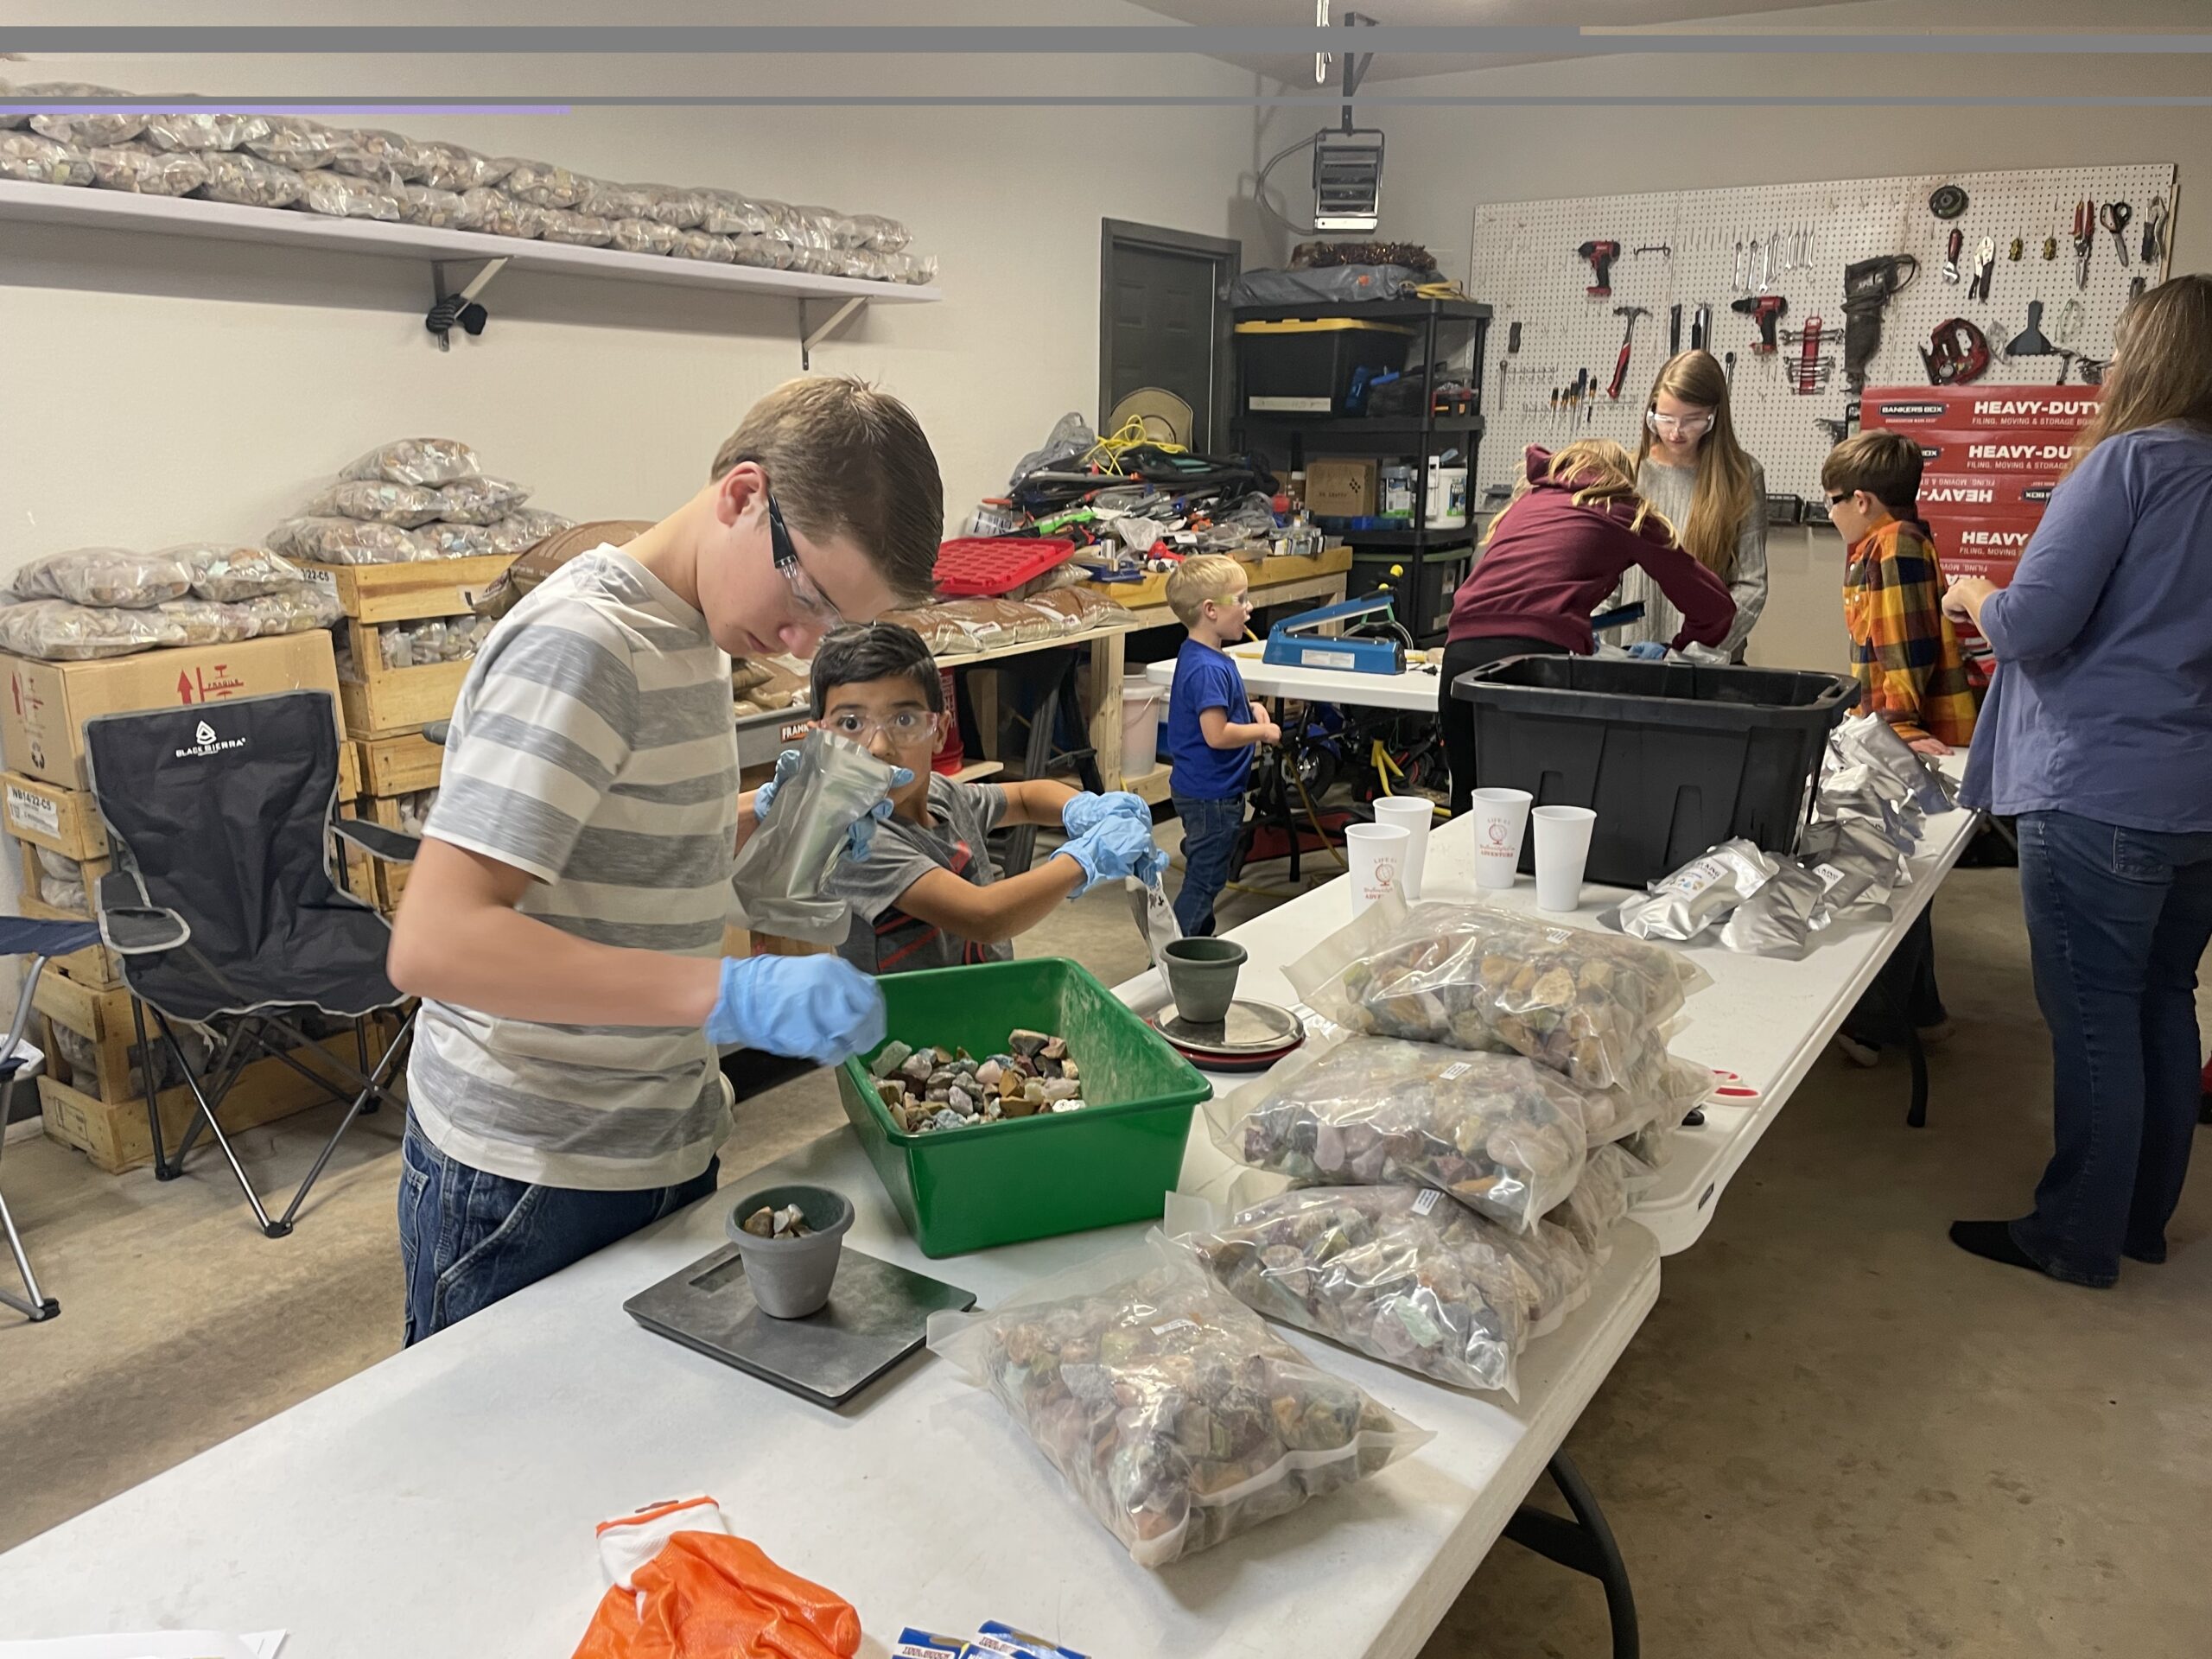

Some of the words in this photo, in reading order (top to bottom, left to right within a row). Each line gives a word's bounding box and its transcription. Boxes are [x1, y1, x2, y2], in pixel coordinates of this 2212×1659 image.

[1974, 401, 2102, 415] HEAVY-DUTY
[1968, 445, 2072, 459] HEAVY-DU
[1961, 531, 2029, 546] HEAVY
[175, 746, 203, 758] BLACK
[204, 740, 245, 753] SIERRA
